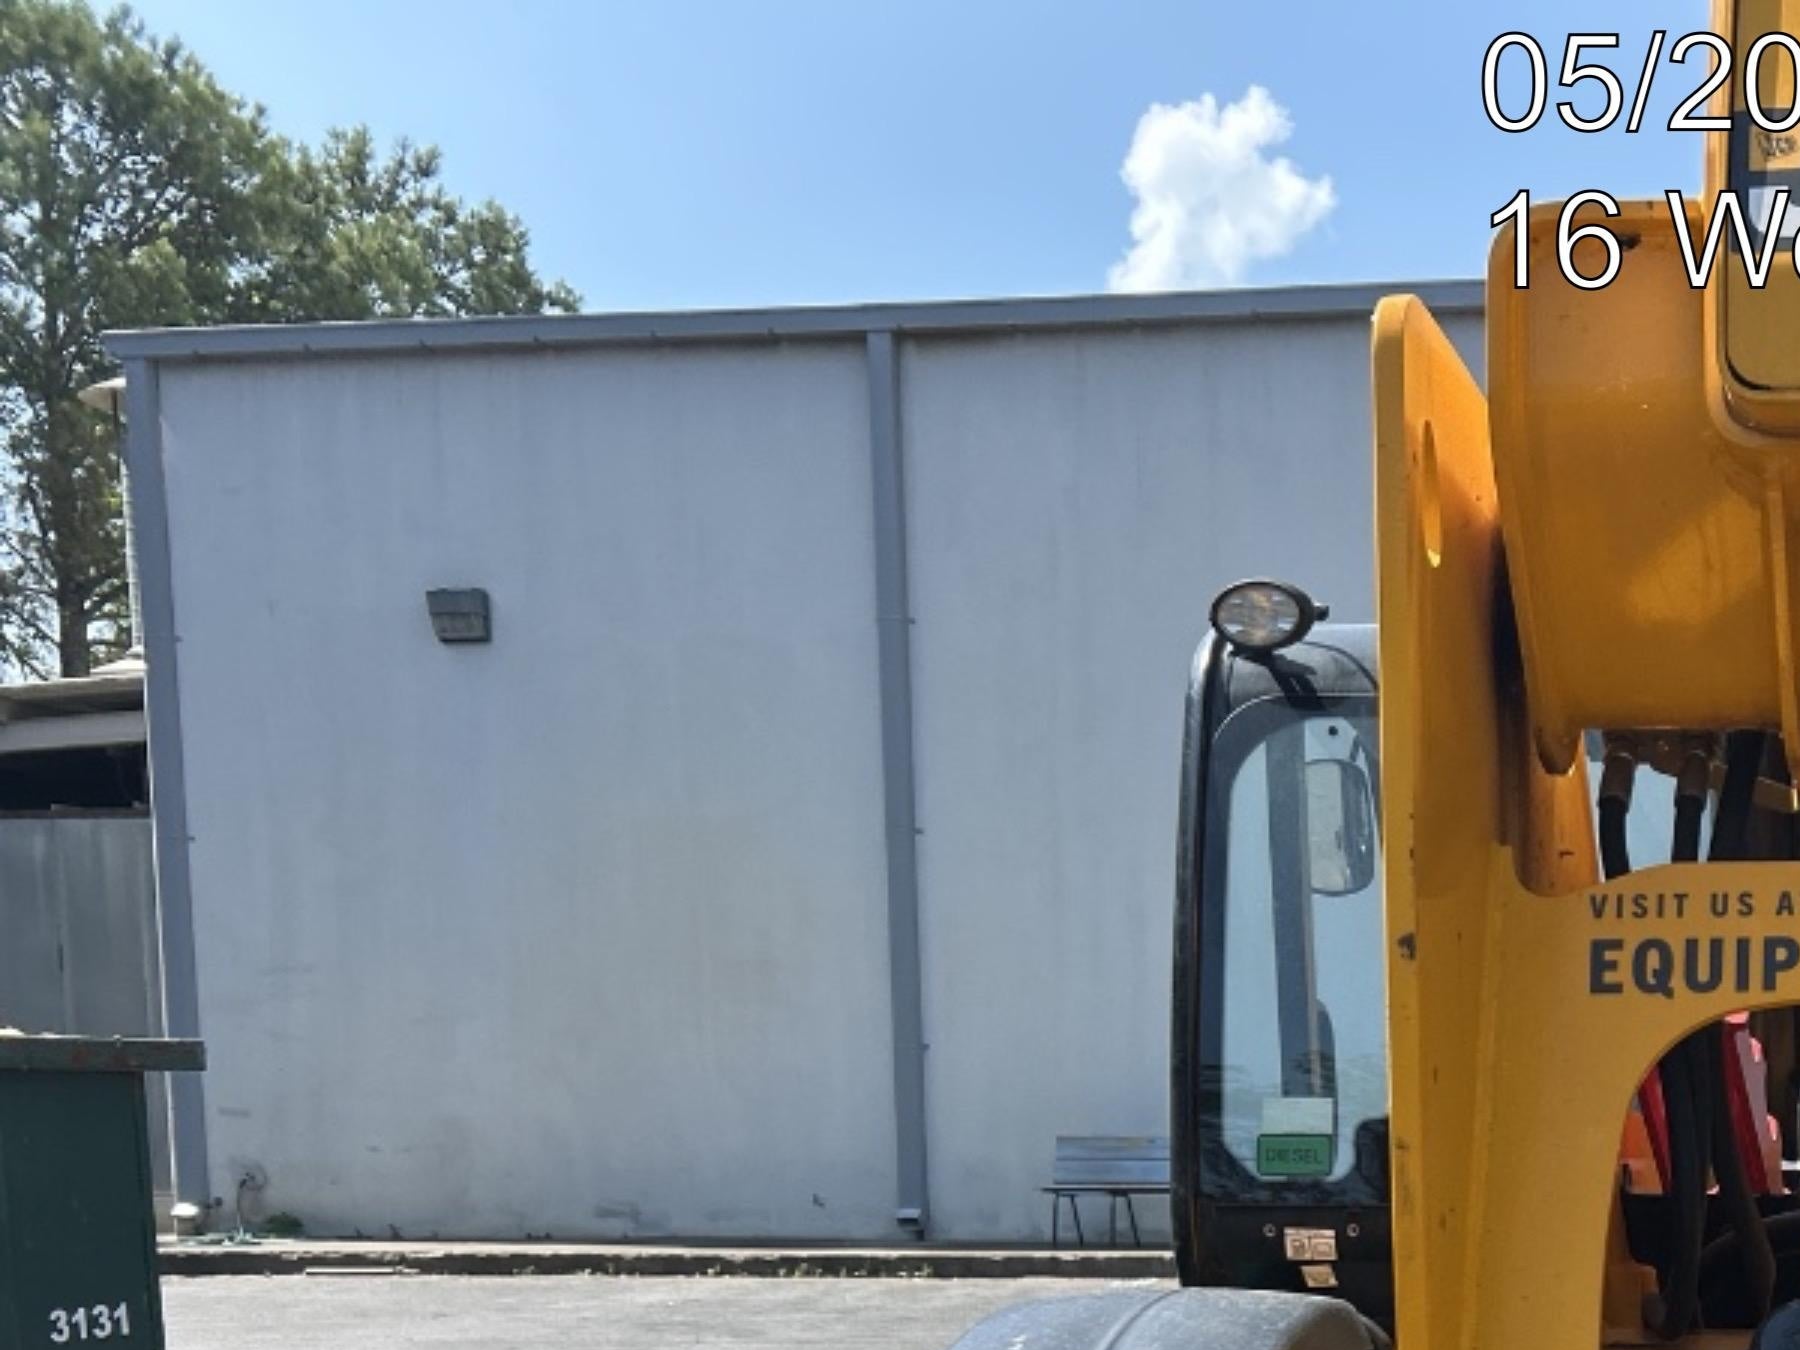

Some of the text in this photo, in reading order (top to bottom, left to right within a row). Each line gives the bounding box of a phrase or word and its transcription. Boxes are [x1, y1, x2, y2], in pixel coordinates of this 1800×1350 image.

[1590, 893, 1689, 919] VISIT
[1710, 892, 1755, 918] US
[1265, 1148, 1324, 1165] DIESEL
[49, 1302, 130, 1342] 3131
